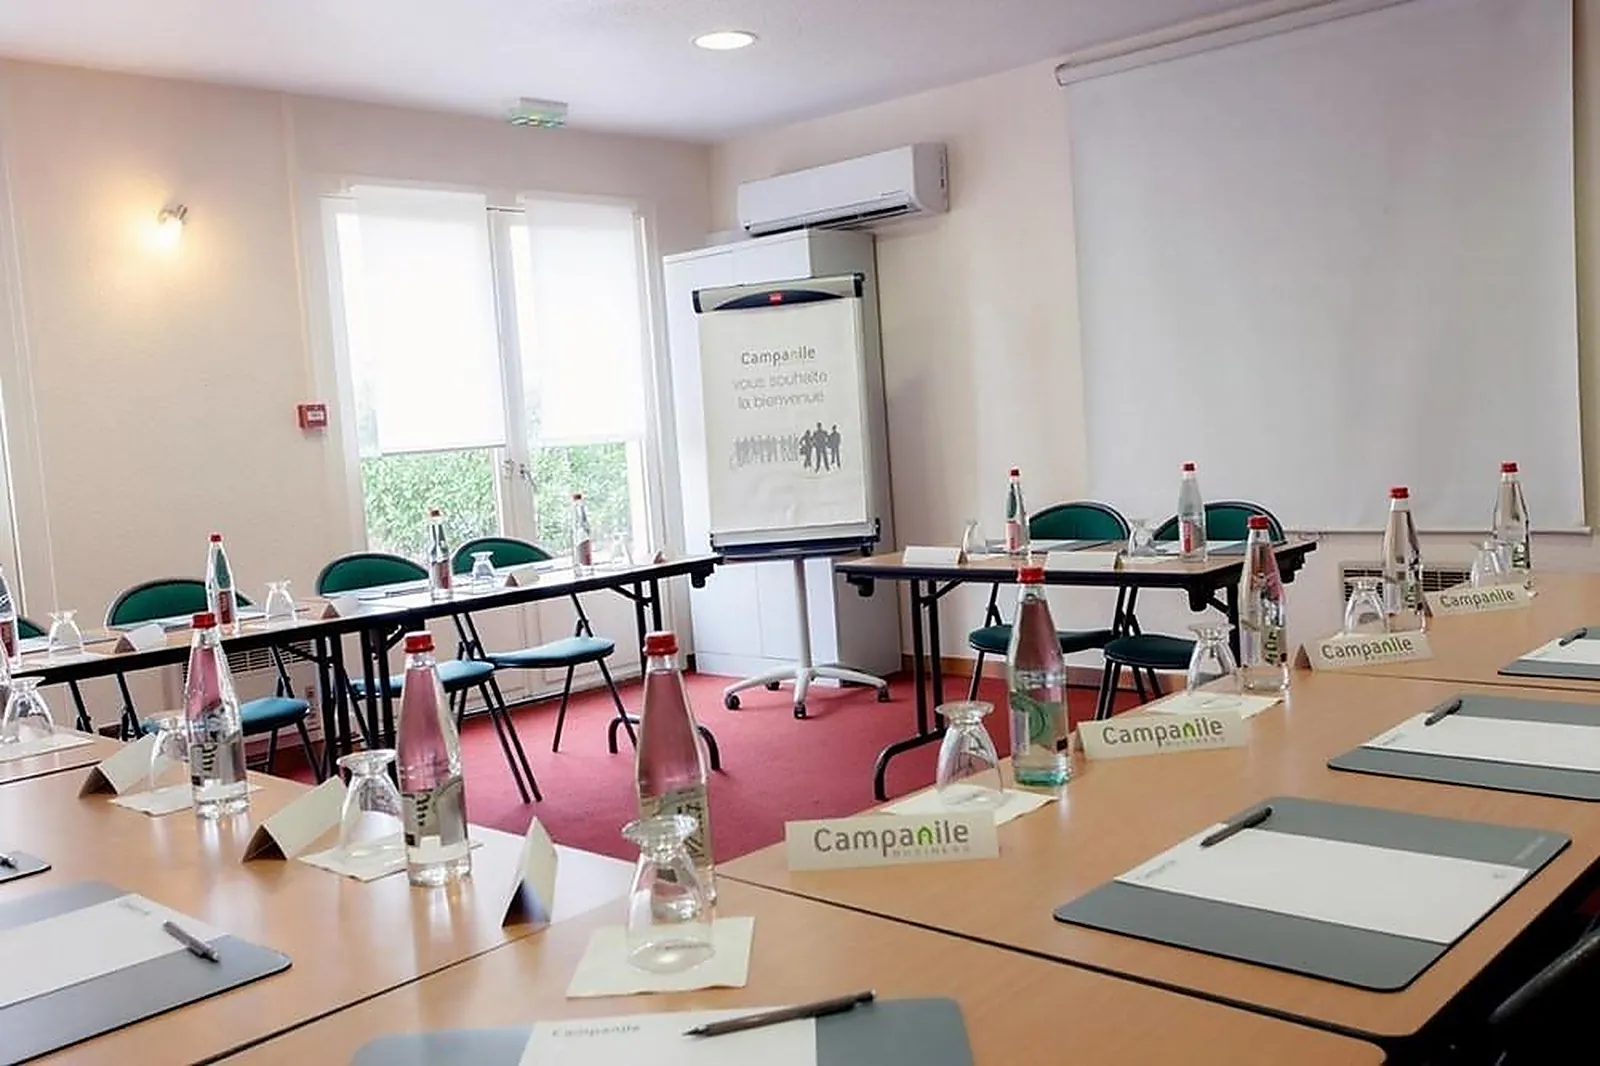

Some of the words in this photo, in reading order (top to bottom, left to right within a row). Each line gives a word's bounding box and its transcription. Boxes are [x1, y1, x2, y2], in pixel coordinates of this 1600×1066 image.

[741, 345, 816, 367] Campanile
[1440, 588, 1515, 610] Campanile
[1321, 636, 1414, 660] Campanile
[1102, 717, 1223, 747] Campanile
[813, 820, 969, 857] Campanile
